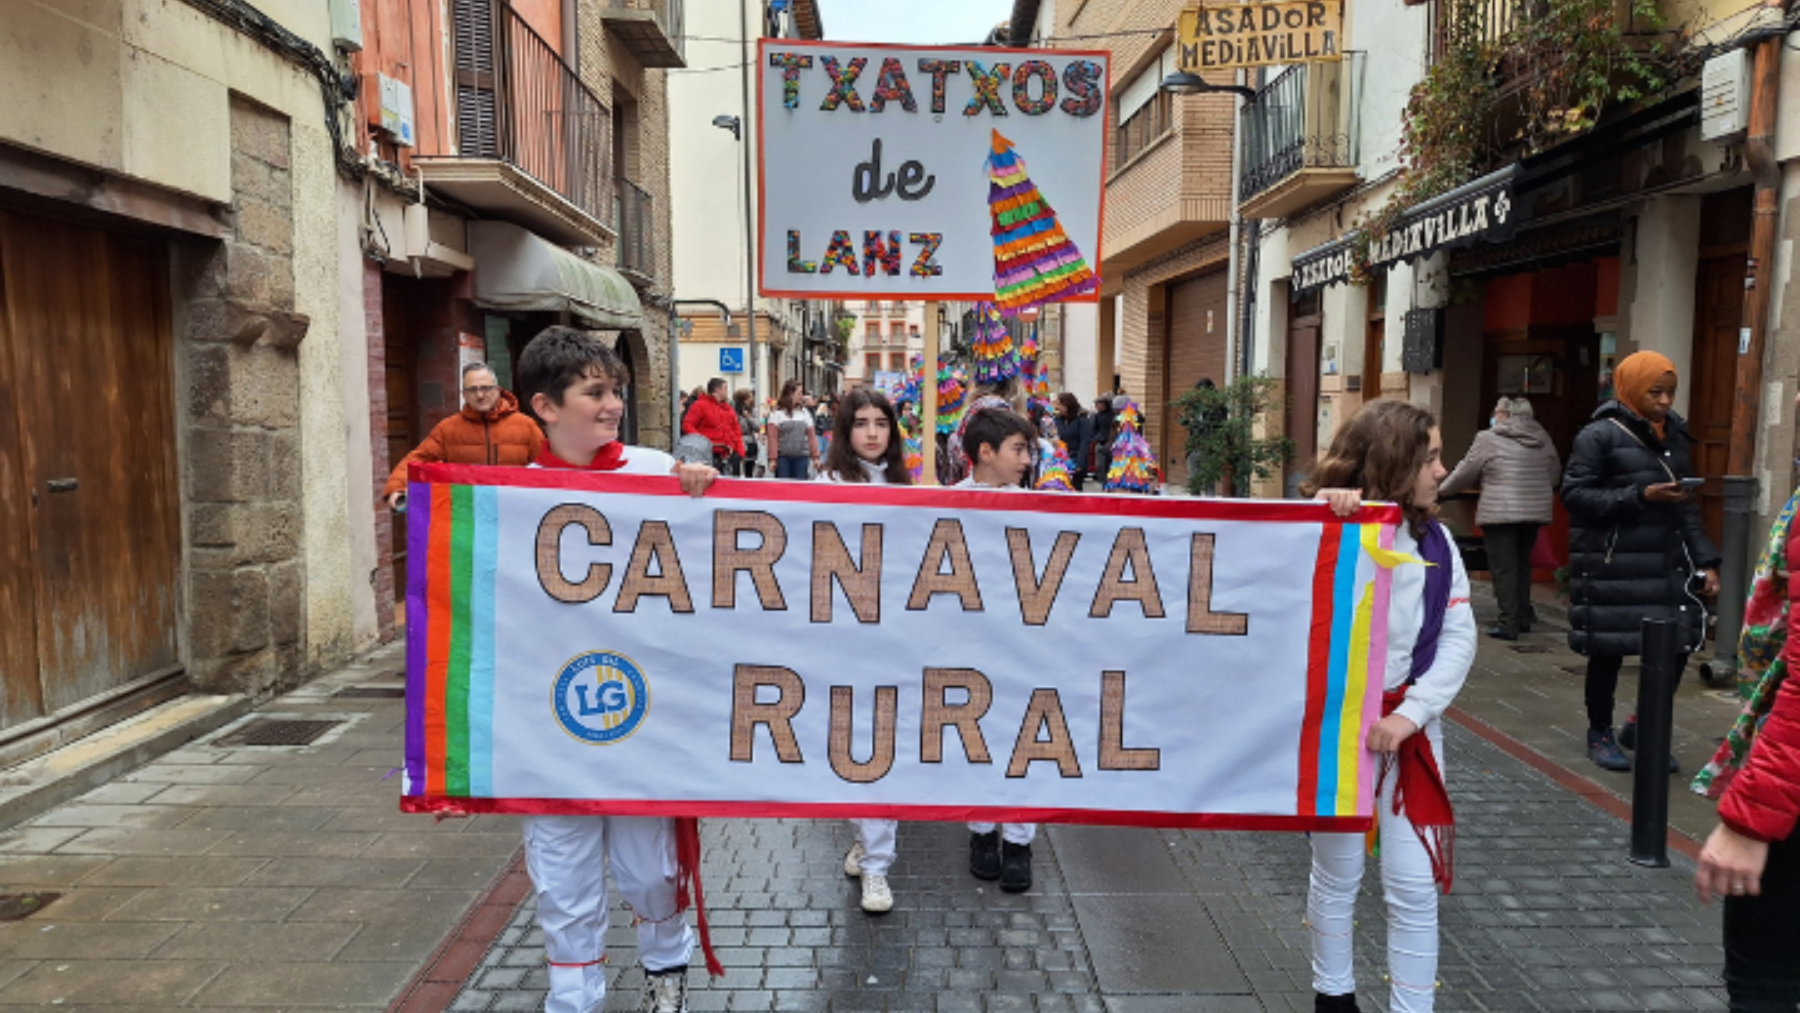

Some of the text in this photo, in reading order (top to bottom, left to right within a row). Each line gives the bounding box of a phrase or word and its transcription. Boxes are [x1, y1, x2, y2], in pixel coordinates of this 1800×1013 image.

[770, 52, 1102, 117] TXATXOS
[852, 138, 935, 203] de
[787, 230, 942, 277] LANZ
[534, 503, 1248, 636] CARNAVAL
[574, 681, 627, 716] LG
[729, 663, 1160, 782] RURAL
